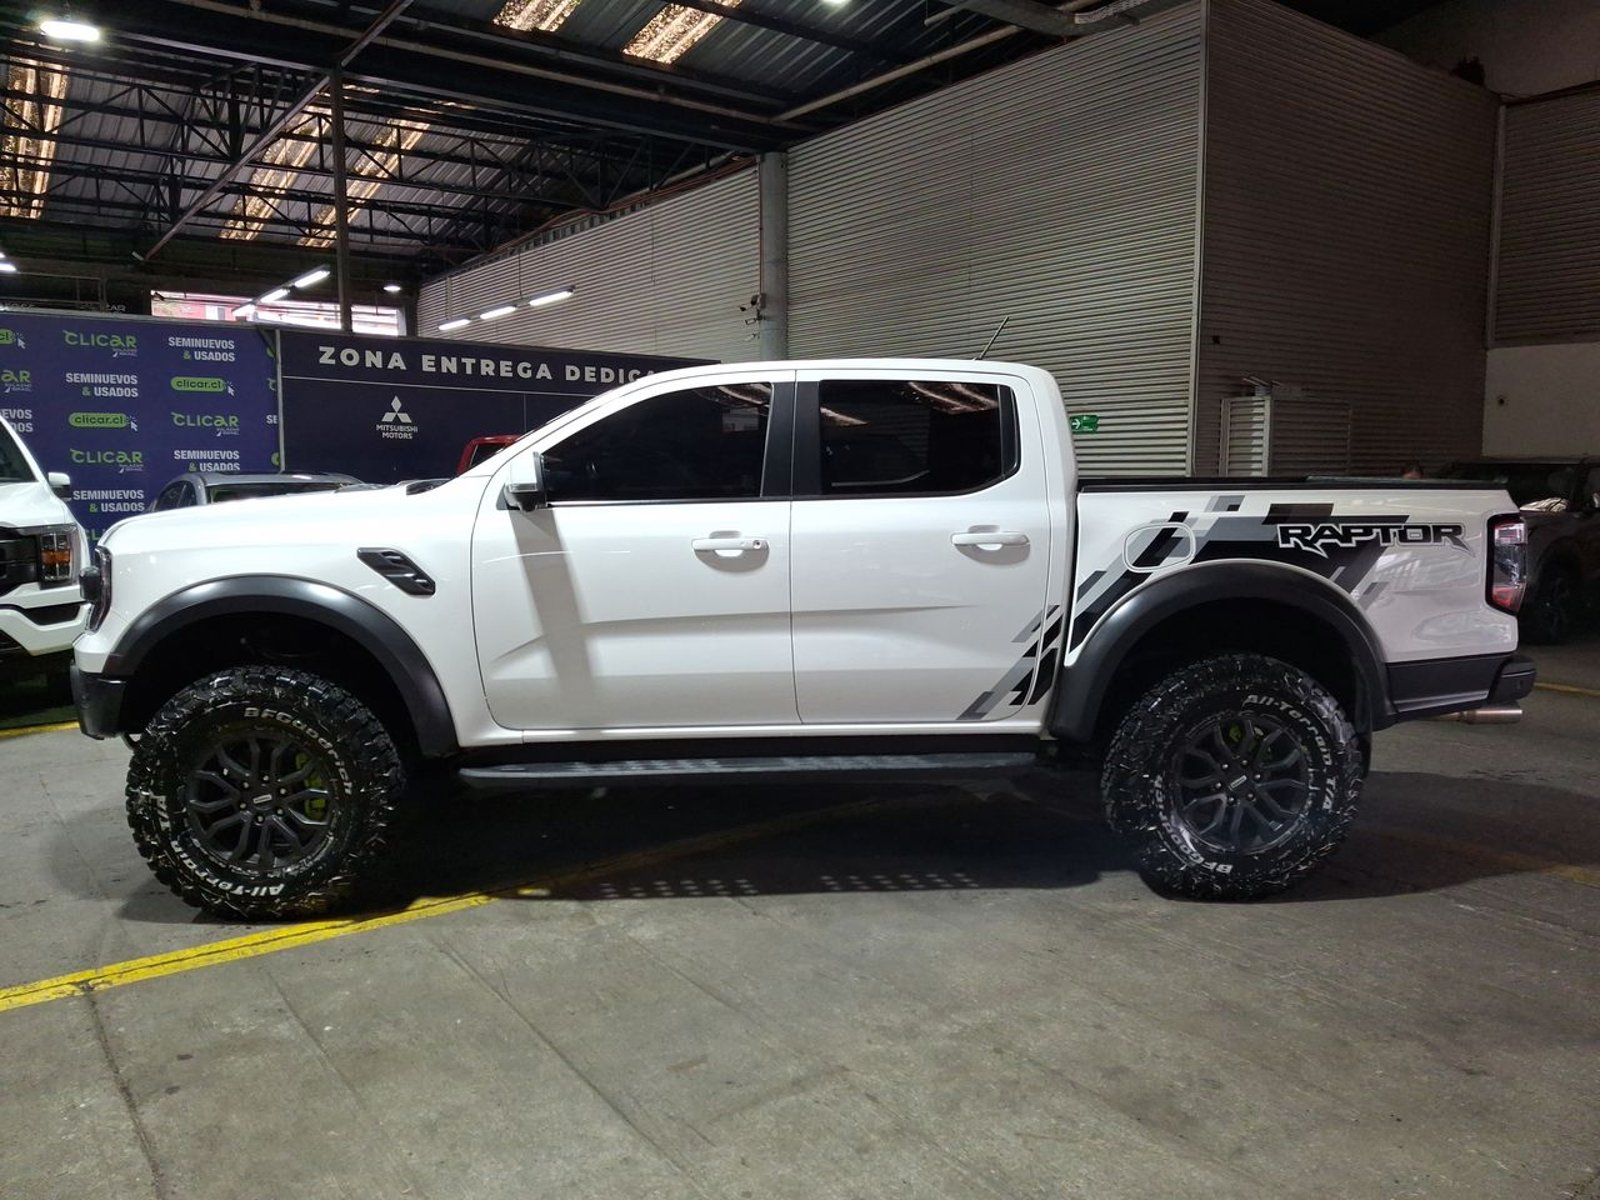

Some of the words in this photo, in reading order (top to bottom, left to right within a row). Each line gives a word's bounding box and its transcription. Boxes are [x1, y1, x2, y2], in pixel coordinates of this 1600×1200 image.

[168, 336, 235, 349] SEMINUEVOS
[183, 351, 191, 360] &
[194, 351, 236, 362] USADOS
[319, 345, 407, 370] ZONA
[421, 354, 553, 381] ENTREGA
[565, 364, 655, 385] DEDIC
[65, 372, 139, 385] SEMINUEVOS
[176, 379, 221, 389] clicar.cl
[82, 386, 91, 396] &
[93, 386, 139, 397] USADOS
[74, 415, 124, 425] clicar.cl
[376, 424, 419, 433] MITSUBISHI
[382, 432, 413, 440] MOTORS
[174, 449, 240, 461] SEMINUEVOS
[188, 462, 197, 472] &
[199, 462, 241, 472] USADOS
[73, 489, 145, 501] SEMINUEVOS
[89, 503, 98, 513] &
[101, 503, 145, 513] USADOS
[1277, 523, 1476, 559] RAPTOR
